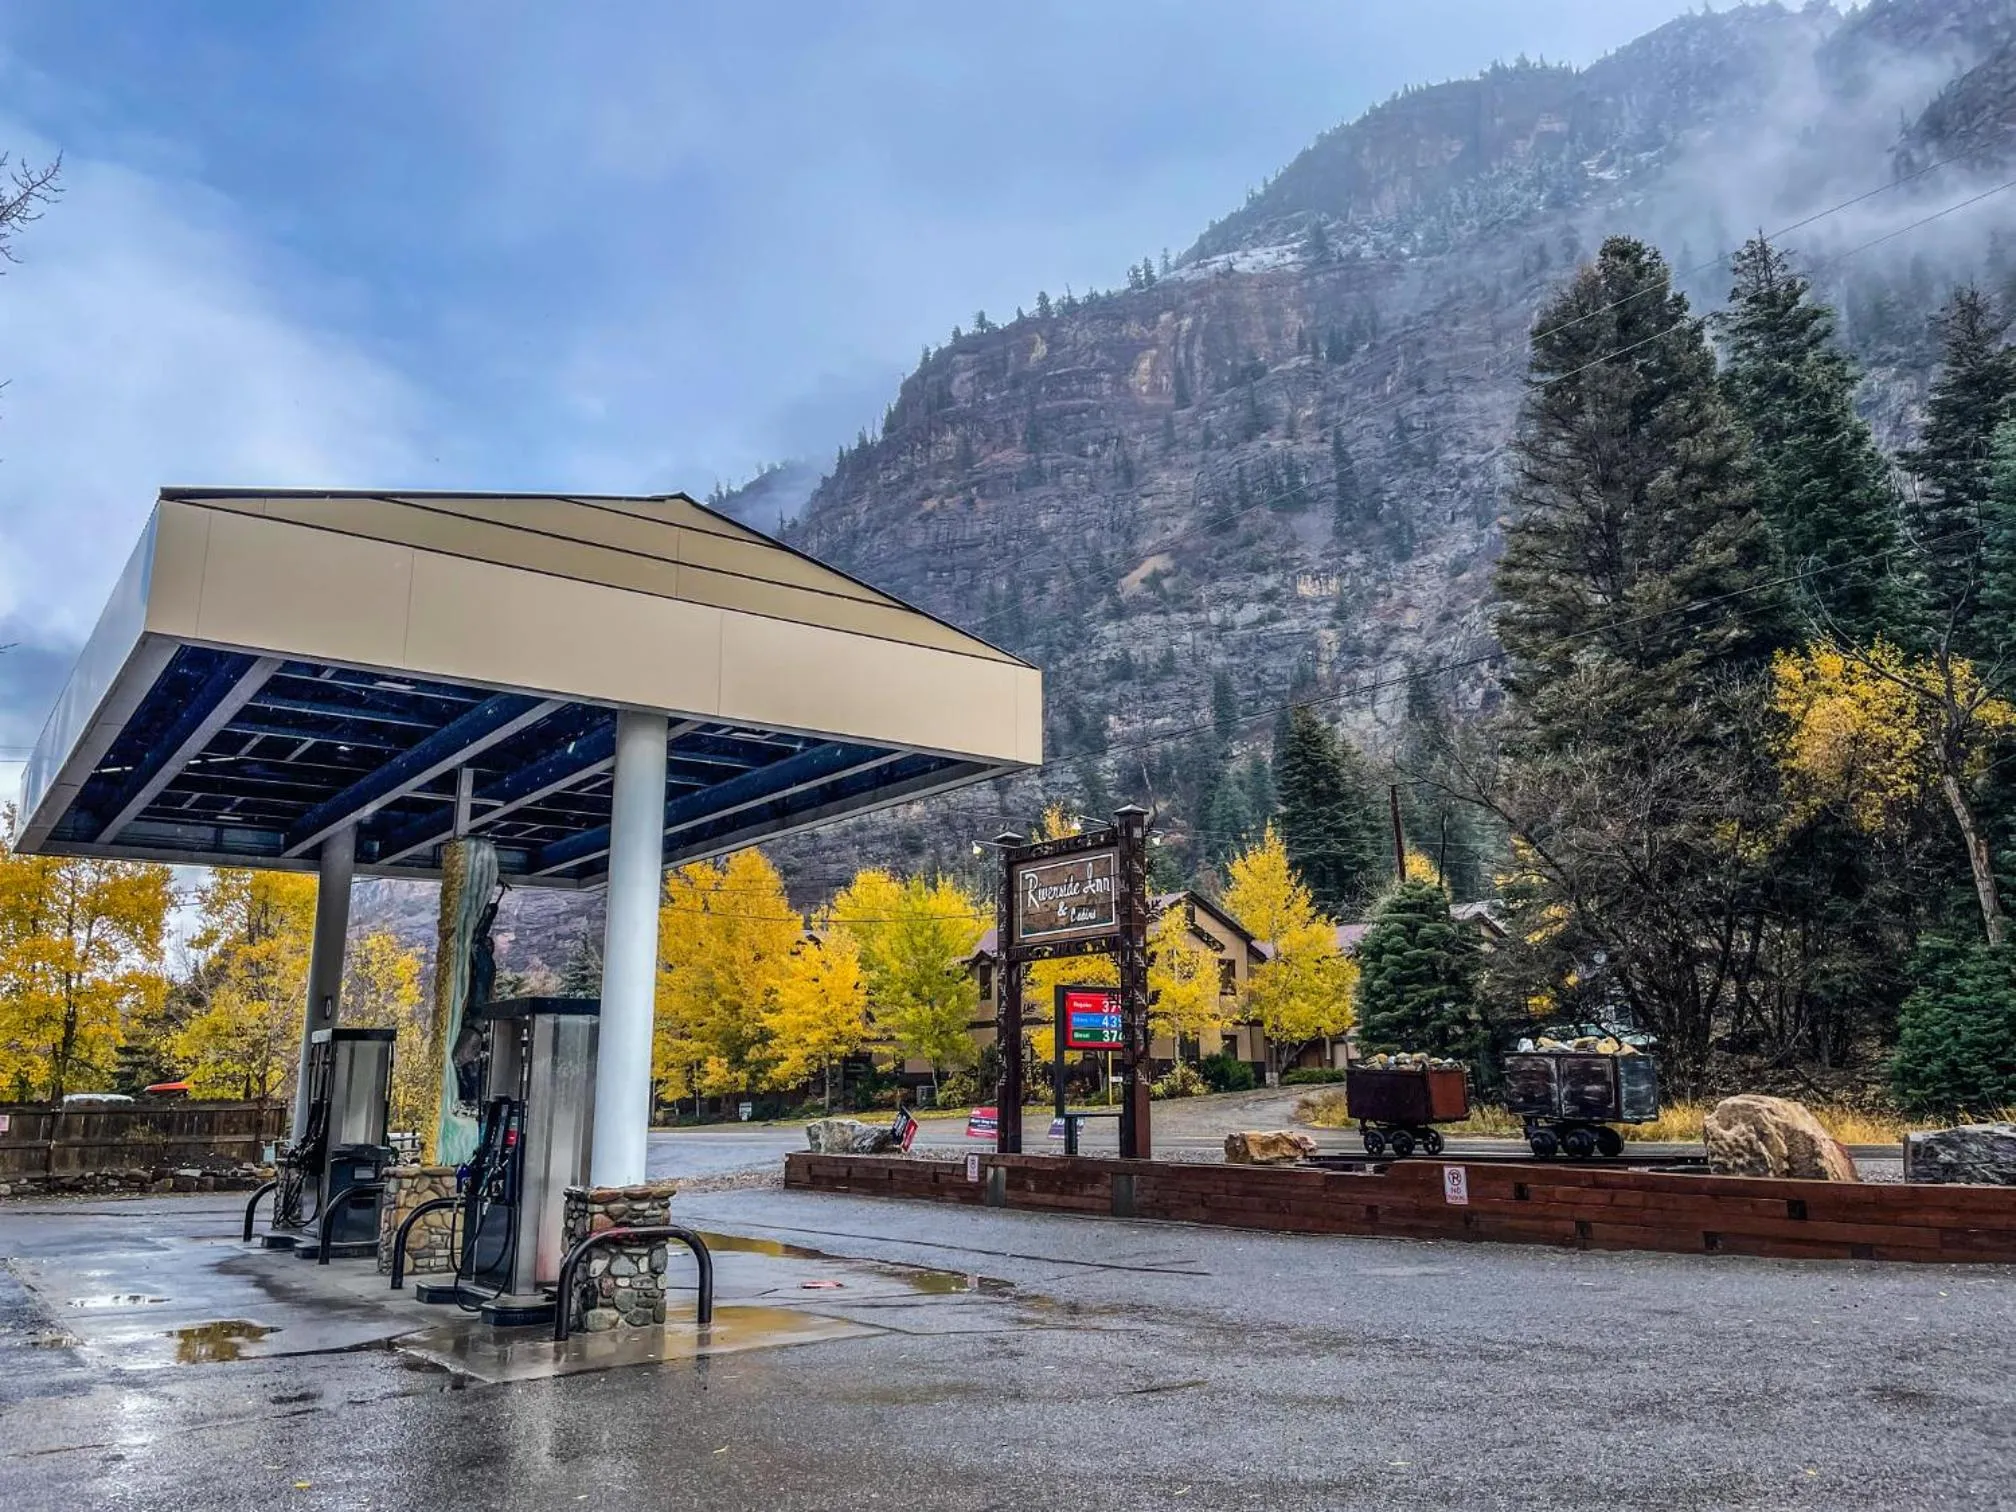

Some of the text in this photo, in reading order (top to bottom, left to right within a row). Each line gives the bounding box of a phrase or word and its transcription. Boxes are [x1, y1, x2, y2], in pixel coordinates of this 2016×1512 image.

[1025, 862, 1110, 908] Riverside Inn
[1057, 901, 1068, 916] &
